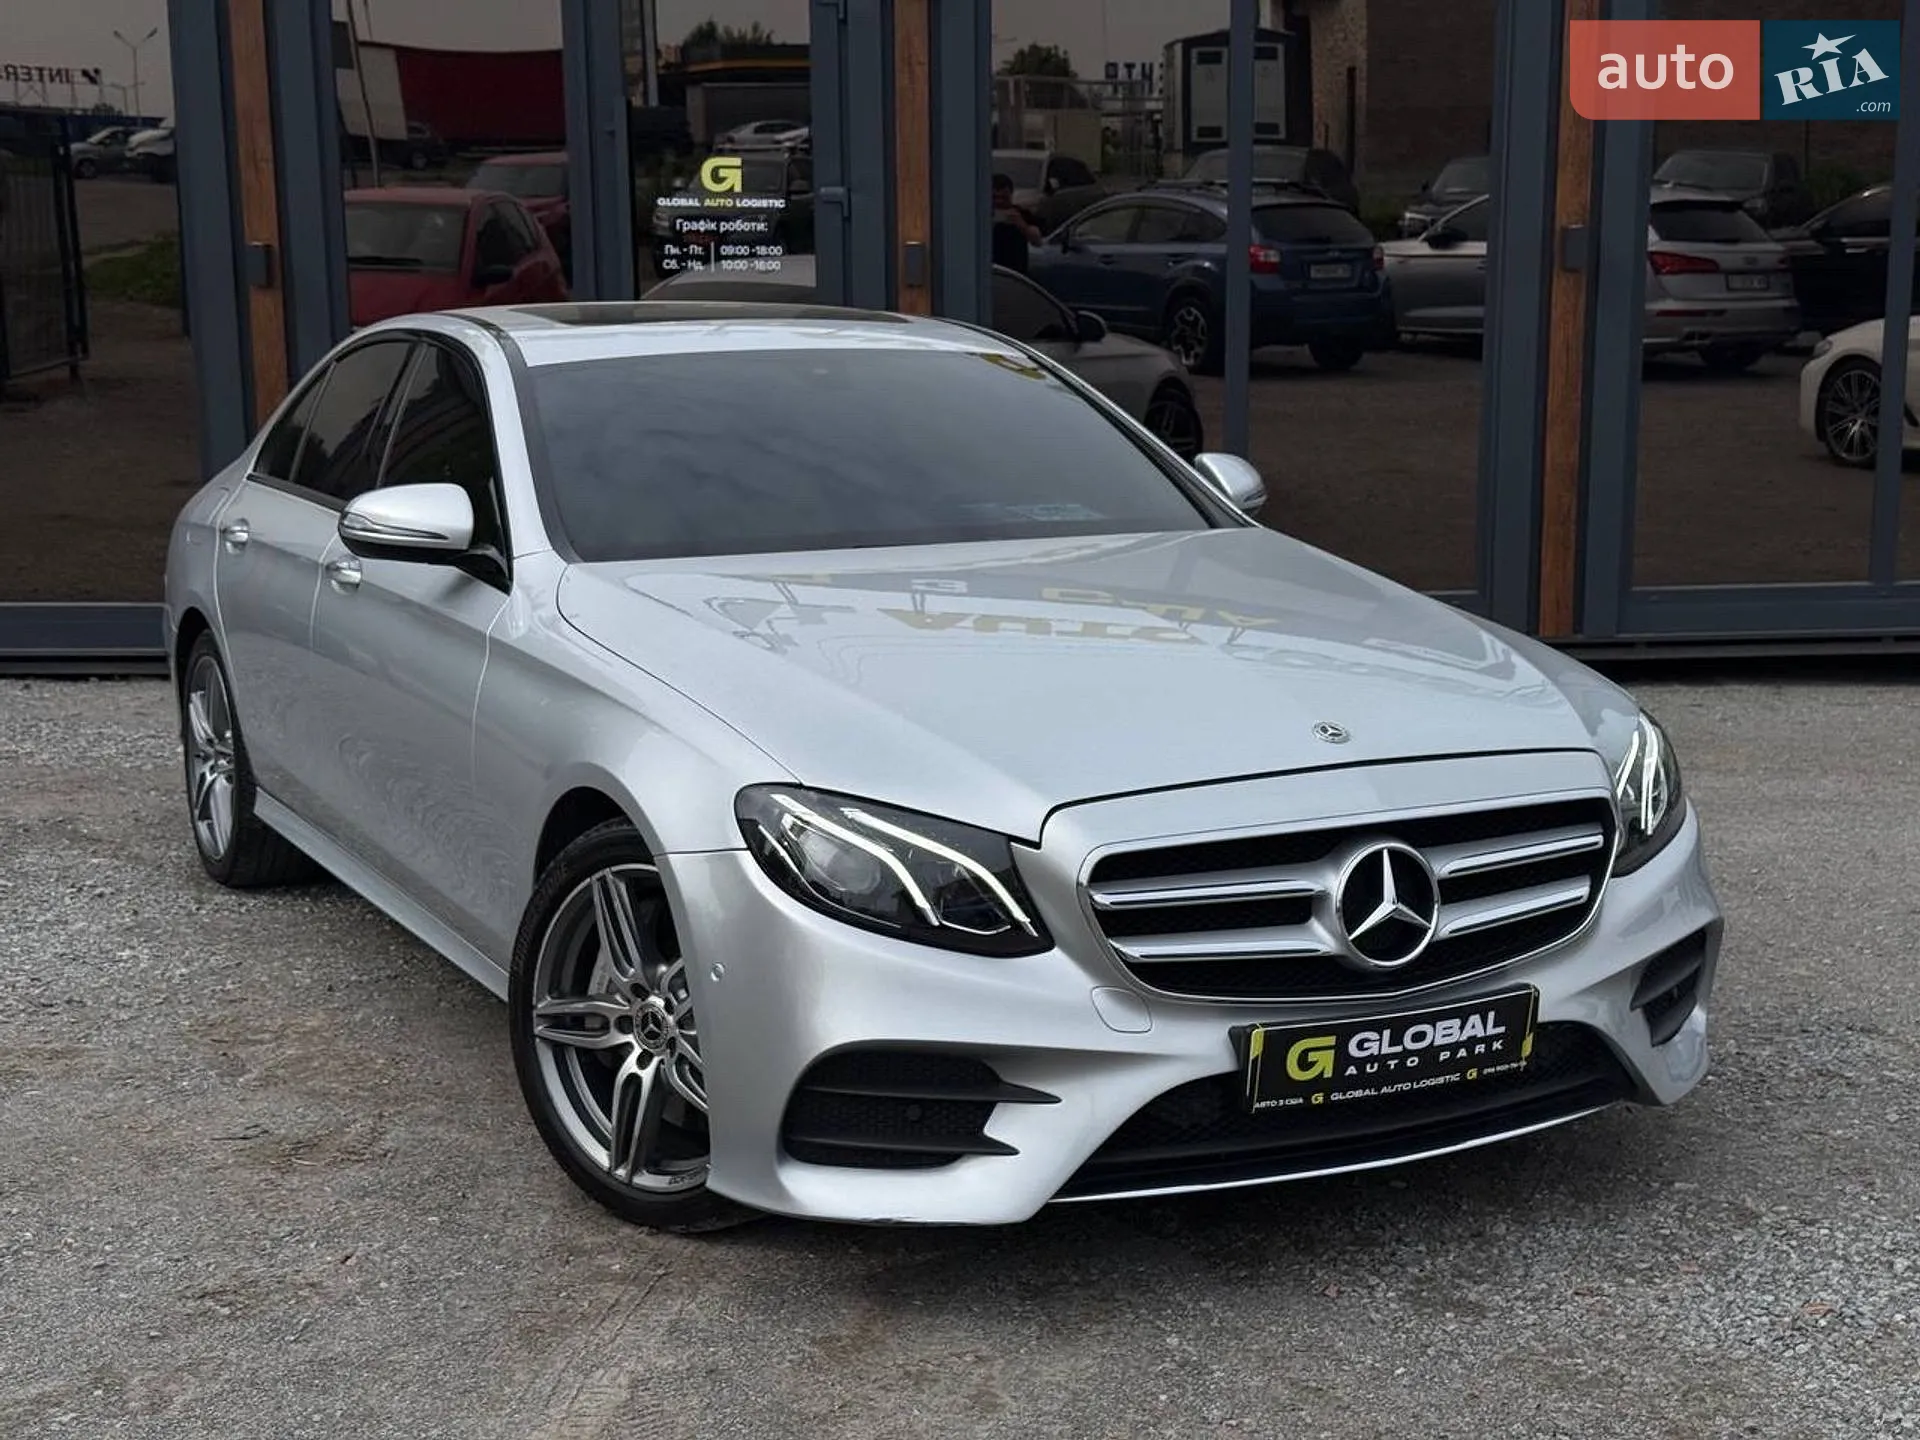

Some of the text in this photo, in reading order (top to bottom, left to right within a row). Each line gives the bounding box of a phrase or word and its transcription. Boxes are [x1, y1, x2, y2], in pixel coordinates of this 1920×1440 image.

[656, 197, 786, 208] GLOBAL AUTO LOGISTIC
[675, 218, 769, 234] Графік роботи:
[719, 245, 750, 256] 09:00
[1347, 1010, 1507, 1058] GLOBAL
[1343, 1039, 1506, 1077] AUTO PARK
[1329, 1072, 1462, 1101] GLOBAL AUTO LOGISTIC
